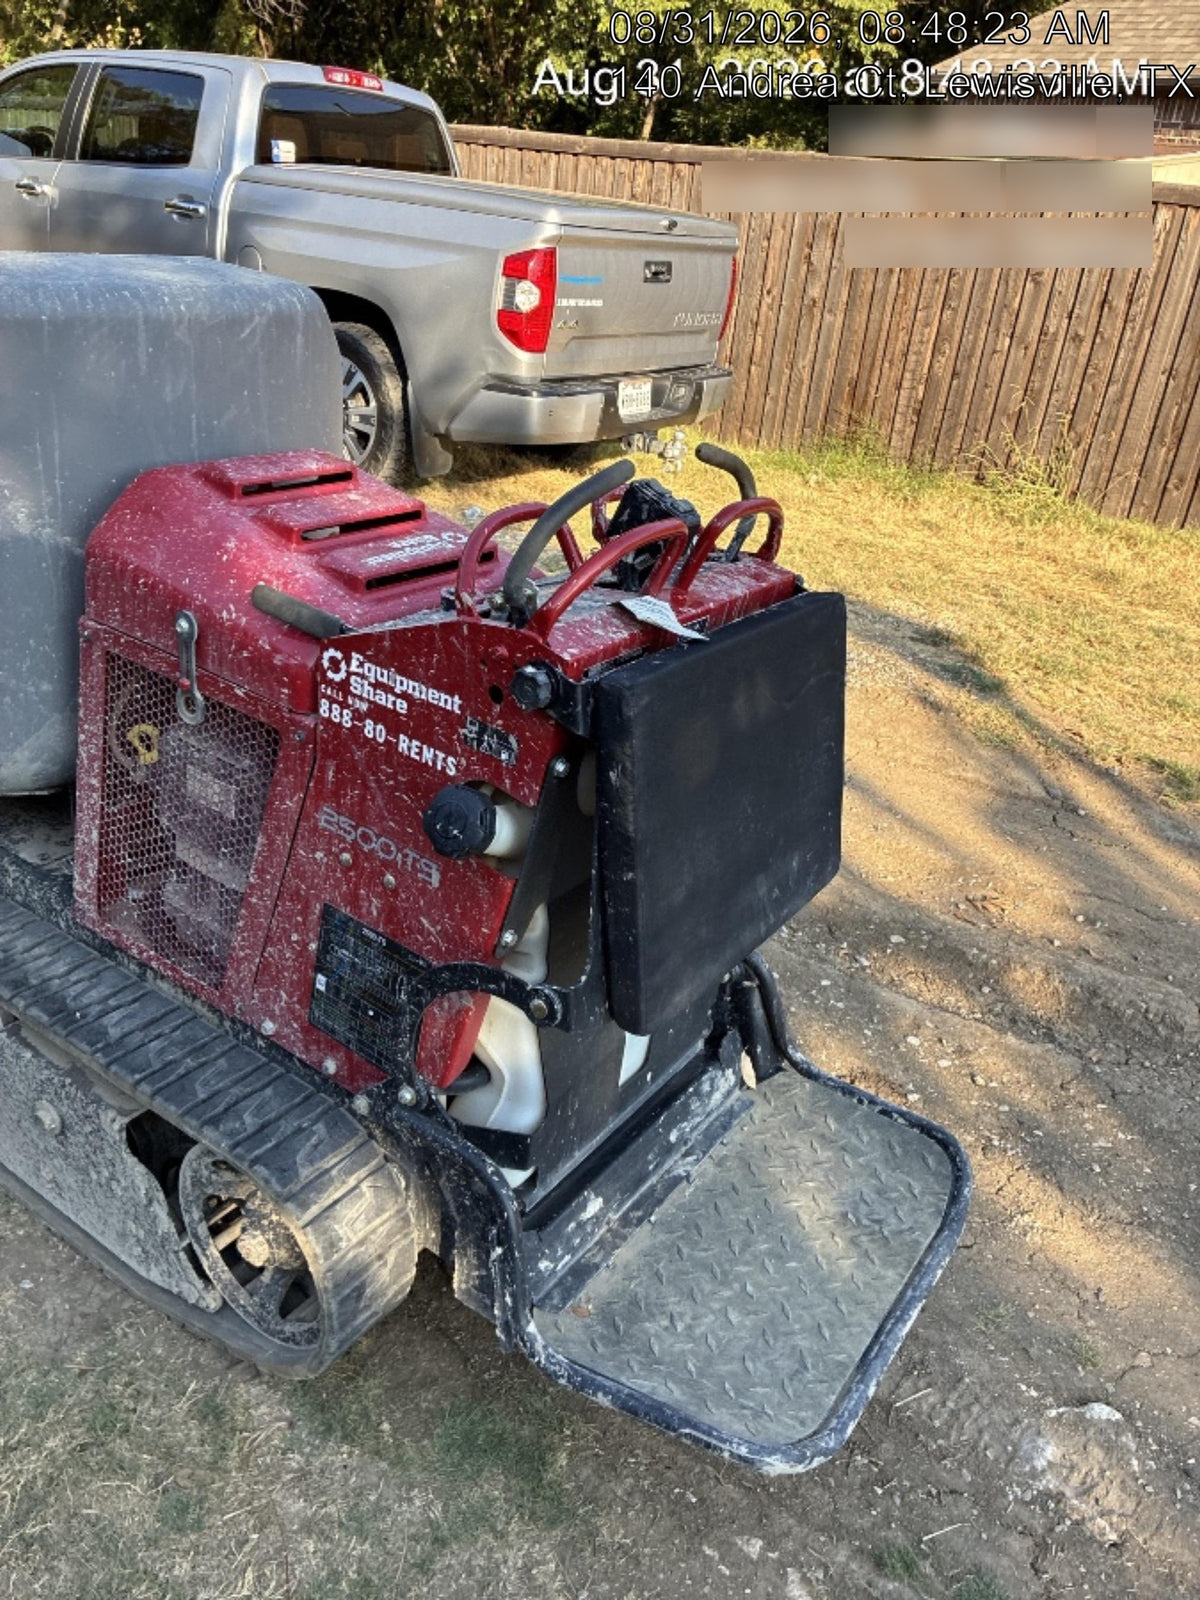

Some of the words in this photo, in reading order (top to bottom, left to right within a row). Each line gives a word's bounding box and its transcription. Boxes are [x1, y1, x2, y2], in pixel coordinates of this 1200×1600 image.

[349, 651, 463, 716] Equipment
[349, 674, 409, 715] Share
[318, 698, 458, 777] 888-80-RENTS
